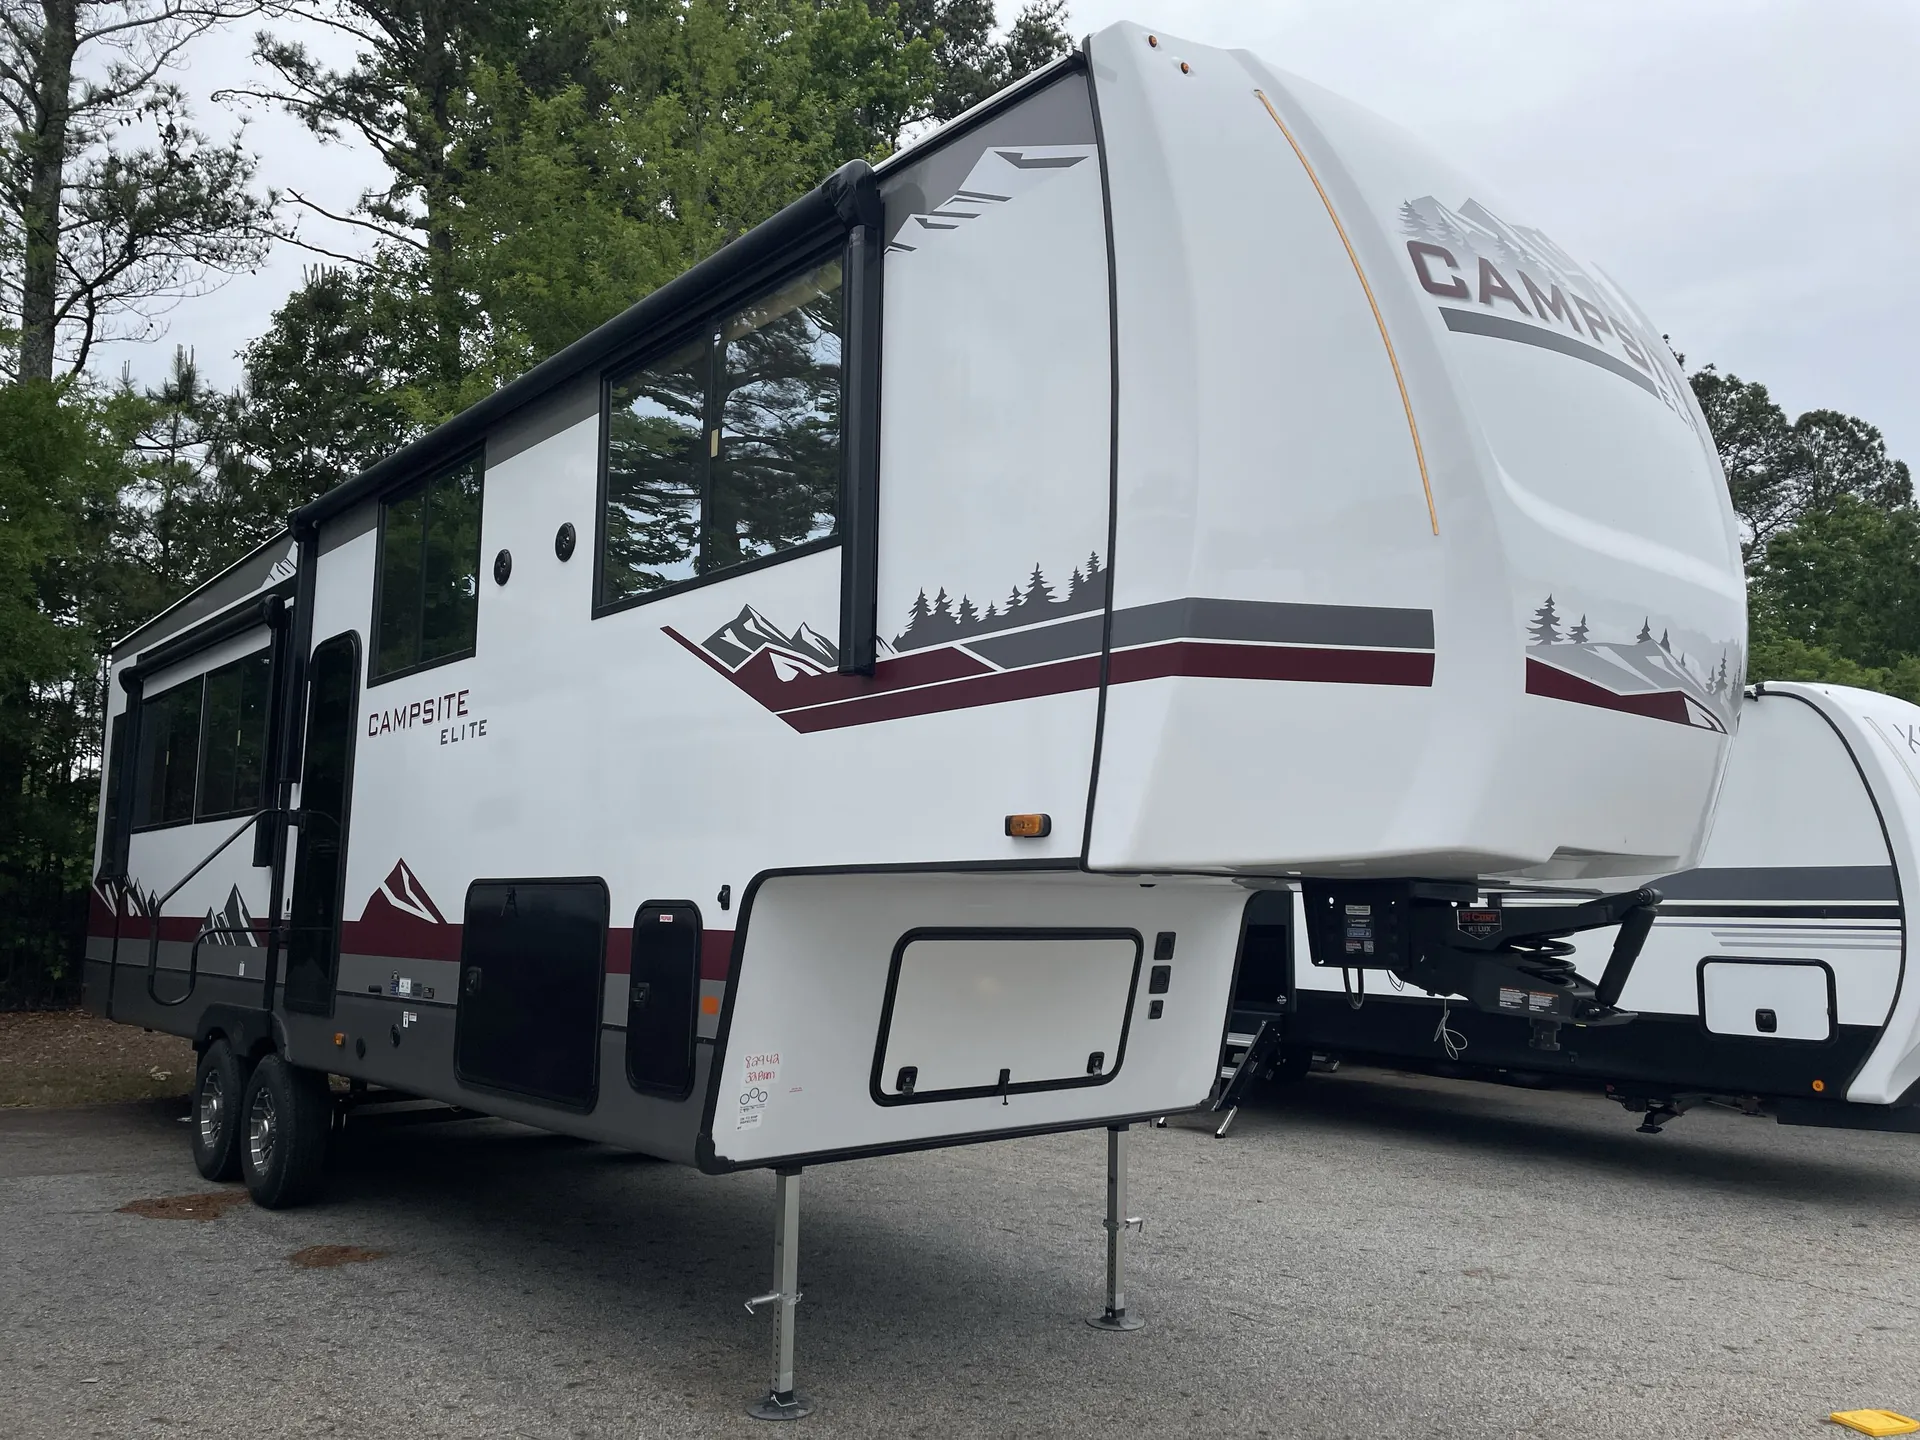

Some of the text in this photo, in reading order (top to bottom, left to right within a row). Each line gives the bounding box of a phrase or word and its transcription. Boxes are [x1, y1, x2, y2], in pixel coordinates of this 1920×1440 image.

[368, 689, 469, 737] CAMPSITE
[440, 719, 488, 746] ELITE
[745, 1053, 780, 1068] 82942
